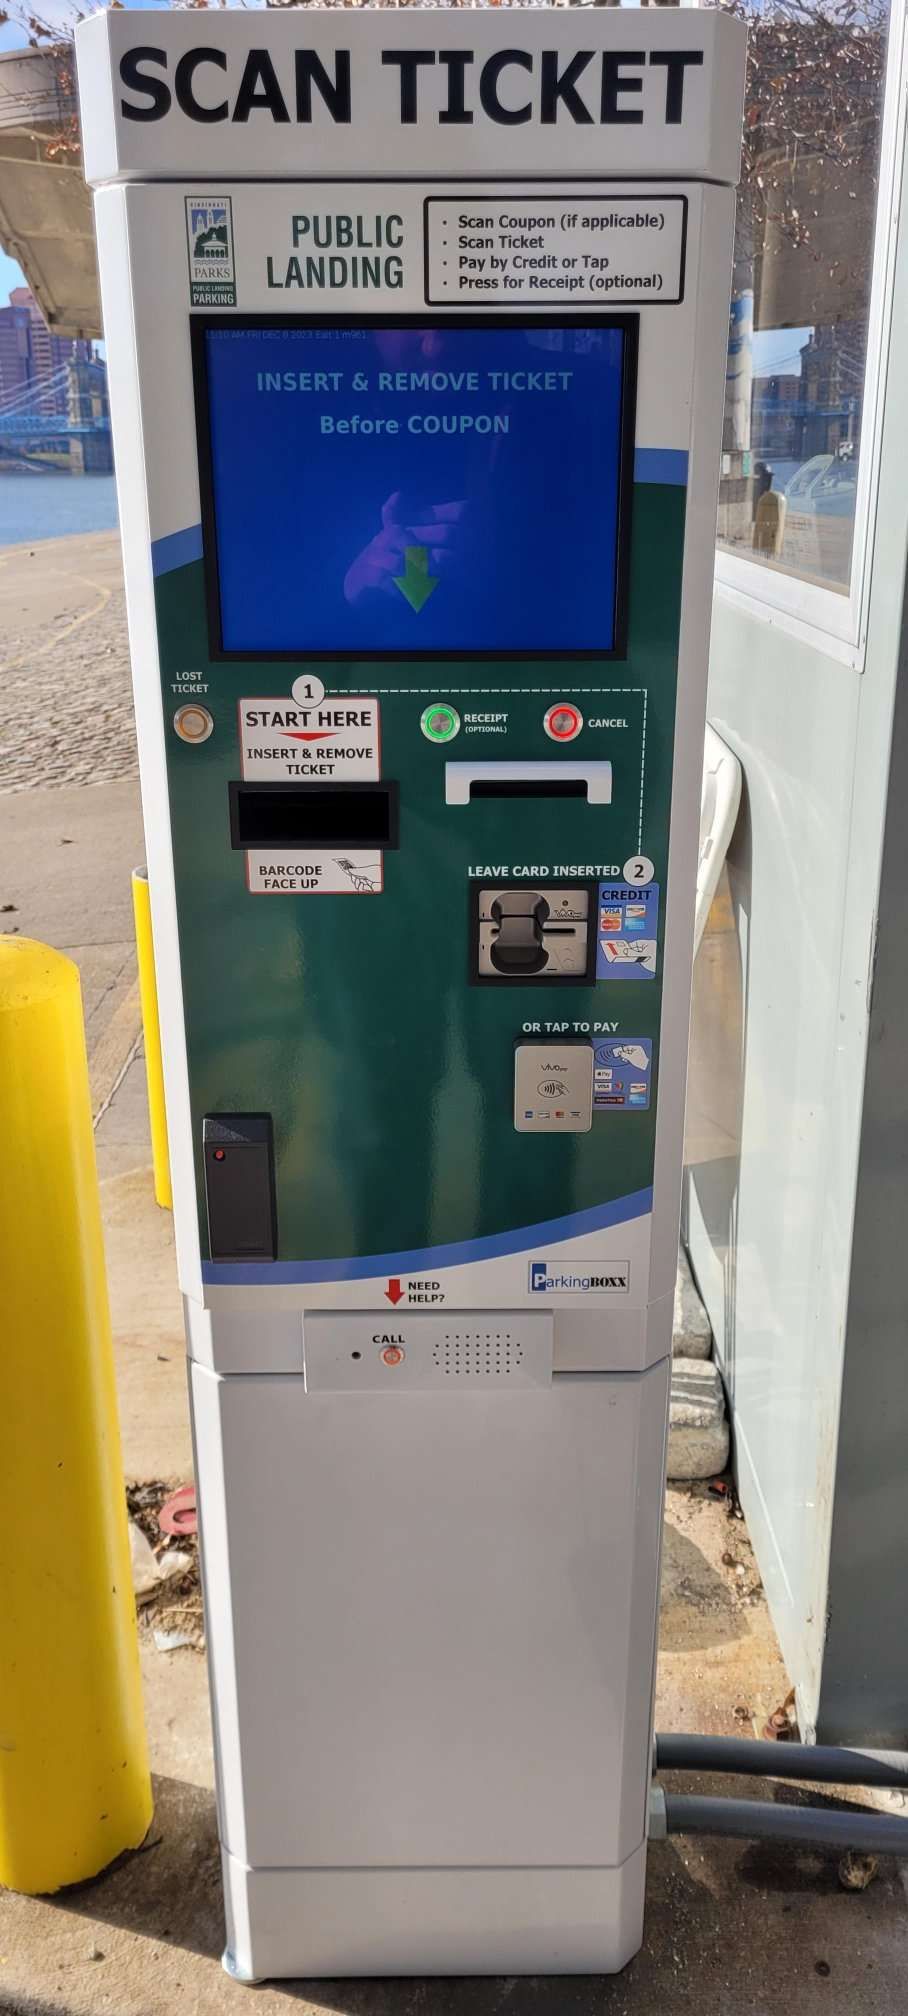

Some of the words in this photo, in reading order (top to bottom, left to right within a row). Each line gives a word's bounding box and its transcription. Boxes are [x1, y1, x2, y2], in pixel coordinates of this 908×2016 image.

[118, 46, 352, 125] SCAN
[381, 49, 704, 125] TICKET
[458, 215, 494, 228] Scan
[498, 215, 555, 231] Coupon
[560, 214, 579, 231] (if
[581, 213, 665, 231] applicable)
[291, 215, 404, 249] PUBLIC
[458, 236, 494, 249] Scan
[498, 235, 545, 249] Ticket
[458, 256, 486, 272] Pay
[490, 256, 508, 272] by
[512, 255, 558, 269] Credit
[561, 258, 578, 269] or
[582, 255, 609, 271] Tap
[194, 267, 231, 279] PARKS
[266, 256, 404, 289] LANDING
[458, 276, 499, 289] Press
[503, 275, 524, 289] for
[529, 276, 585, 291] Receipt
[589, 274, 663, 291] (optional)
[193, 293, 234, 304] PARKING
[256, 372, 343, 392] INSERT
[351, 372, 369, 392] &
[378, 372, 480, 392] REMOVE
[488, 372, 573, 391] TICKET
[320, 415, 399, 434] Before
[407, 414, 510, 434] COUPON
[175, 671, 203, 681] LOST
[170, 684, 209, 694] TICKET
[303, 684, 314, 699] 1
[246, 711, 311, 728] START
[318, 711, 372, 727] HERE
[463, 713, 509, 723] RECEIPT
[588, 718, 629, 729] CANCEL
[465, 726, 508, 734] (OPTIONAL)
[247, 748, 299, 760] INSERT
[302, 748, 312, 760] &
[316, 748, 373, 760] REMOVE
[286, 764, 335, 775] TICKET
[258, 865, 323, 877] BARCODE
[468, 866, 509, 877] LEAVE
[512, 865, 549, 877] CARD
[553, 865, 621, 877] INSERTED
[633, 864, 645, 879] 2
[264, 878, 297, 889] FACE
[301, 878, 319, 889] UP
[601, 890, 652, 901] CREDIT
[522, 1022, 541, 1032] OR
[544, 1022, 569, 1032] TAP
[573, 1022, 590, 1032] TO
[594, 1022, 619, 1032] PAY
[408, 1281, 440, 1290] NEED
[408, 1294, 445, 1303] HELP?
[372, 1335, 406, 1344] CALL
